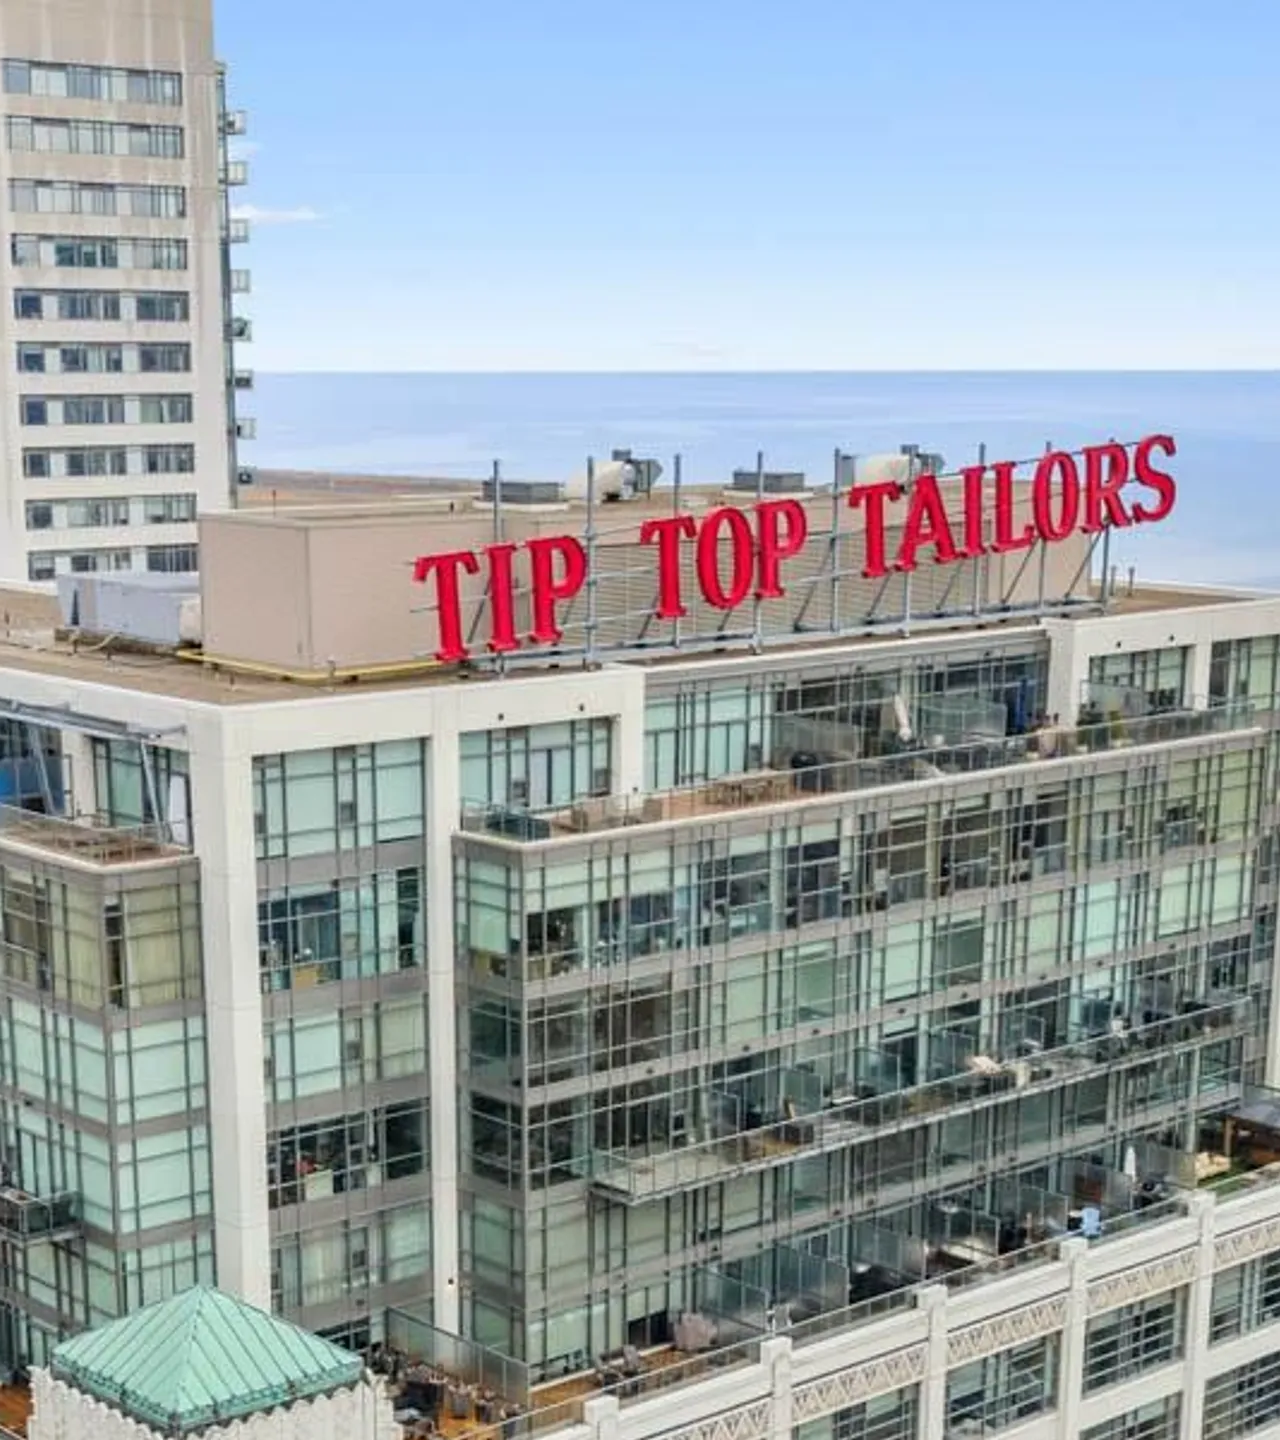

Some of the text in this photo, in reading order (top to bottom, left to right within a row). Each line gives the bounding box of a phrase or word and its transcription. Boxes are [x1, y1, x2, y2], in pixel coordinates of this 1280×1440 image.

[412, 434, 1177, 664] TIP TOP TAILORS
